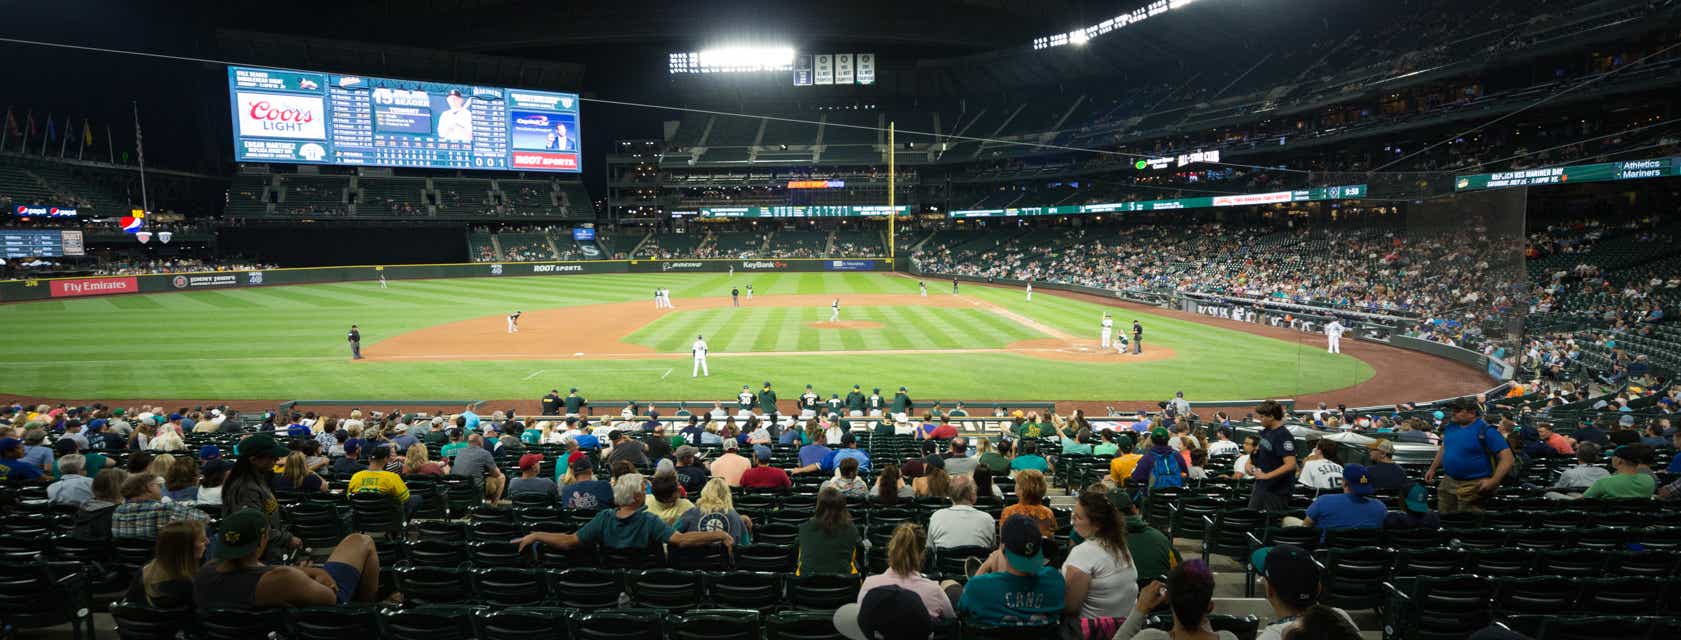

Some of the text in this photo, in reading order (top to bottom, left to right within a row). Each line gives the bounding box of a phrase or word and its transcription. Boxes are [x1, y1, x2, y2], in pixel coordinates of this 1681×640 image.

[249, 100, 314, 123] Coors
[264, 122, 303, 131] LIGHT
[476, 158, 482, 166] 0
[488, 158, 494, 166] 0
[516, 156, 543, 164] ROOT
[1624, 160, 1660, 170] Athletics
[1526, 169, 1551, 178] MARINER
[1622, 169, 1660, 178] Mariners
[64, 281, 126, 292] Fly Emirates
